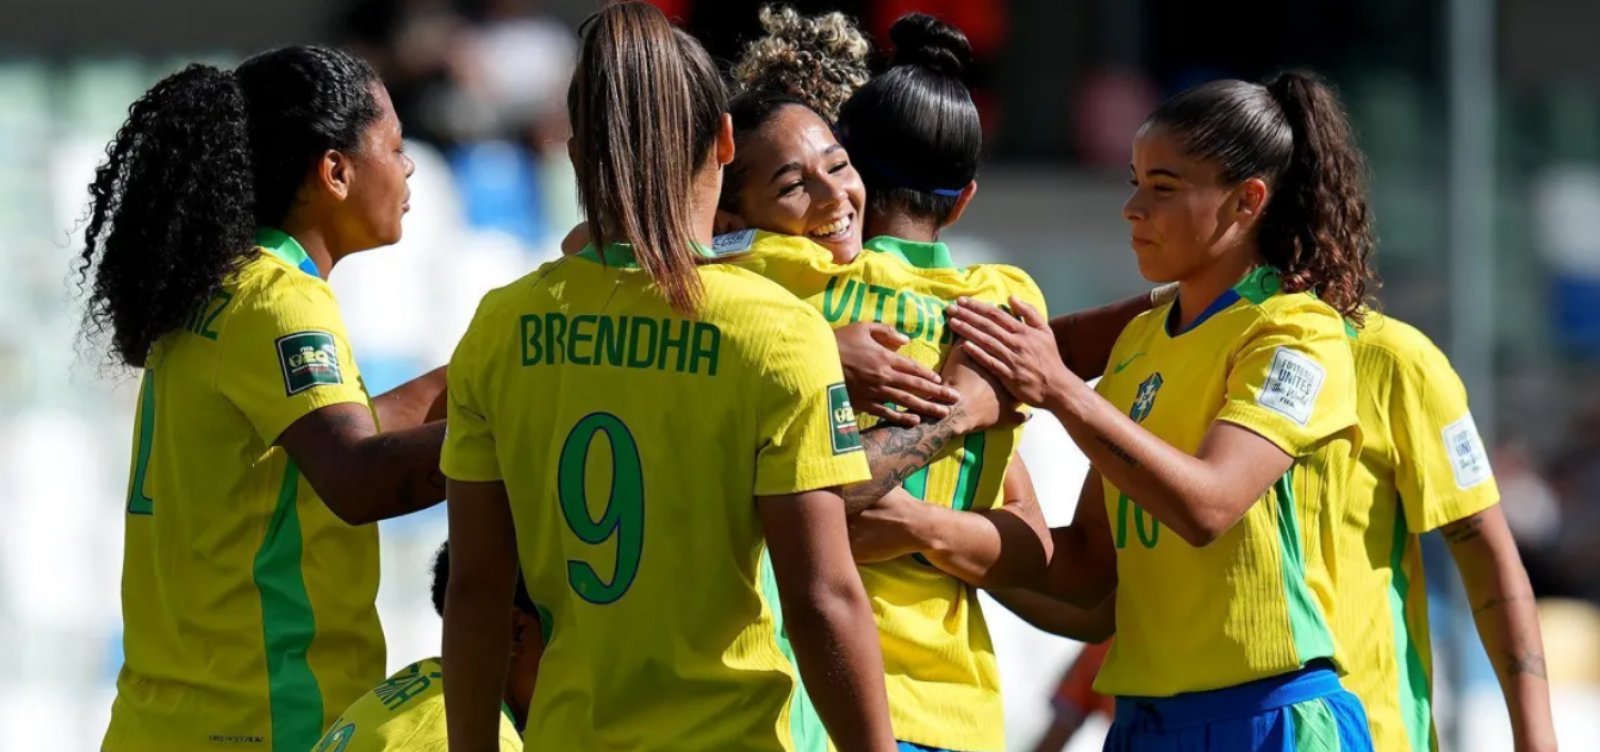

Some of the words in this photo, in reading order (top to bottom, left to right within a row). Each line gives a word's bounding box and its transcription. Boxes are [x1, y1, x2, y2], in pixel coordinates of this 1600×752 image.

[520, 313, 721, 376] BRENDHA
[1278, 368, 1313, 396] UNITES
[557, 411, 645, 606] 9
